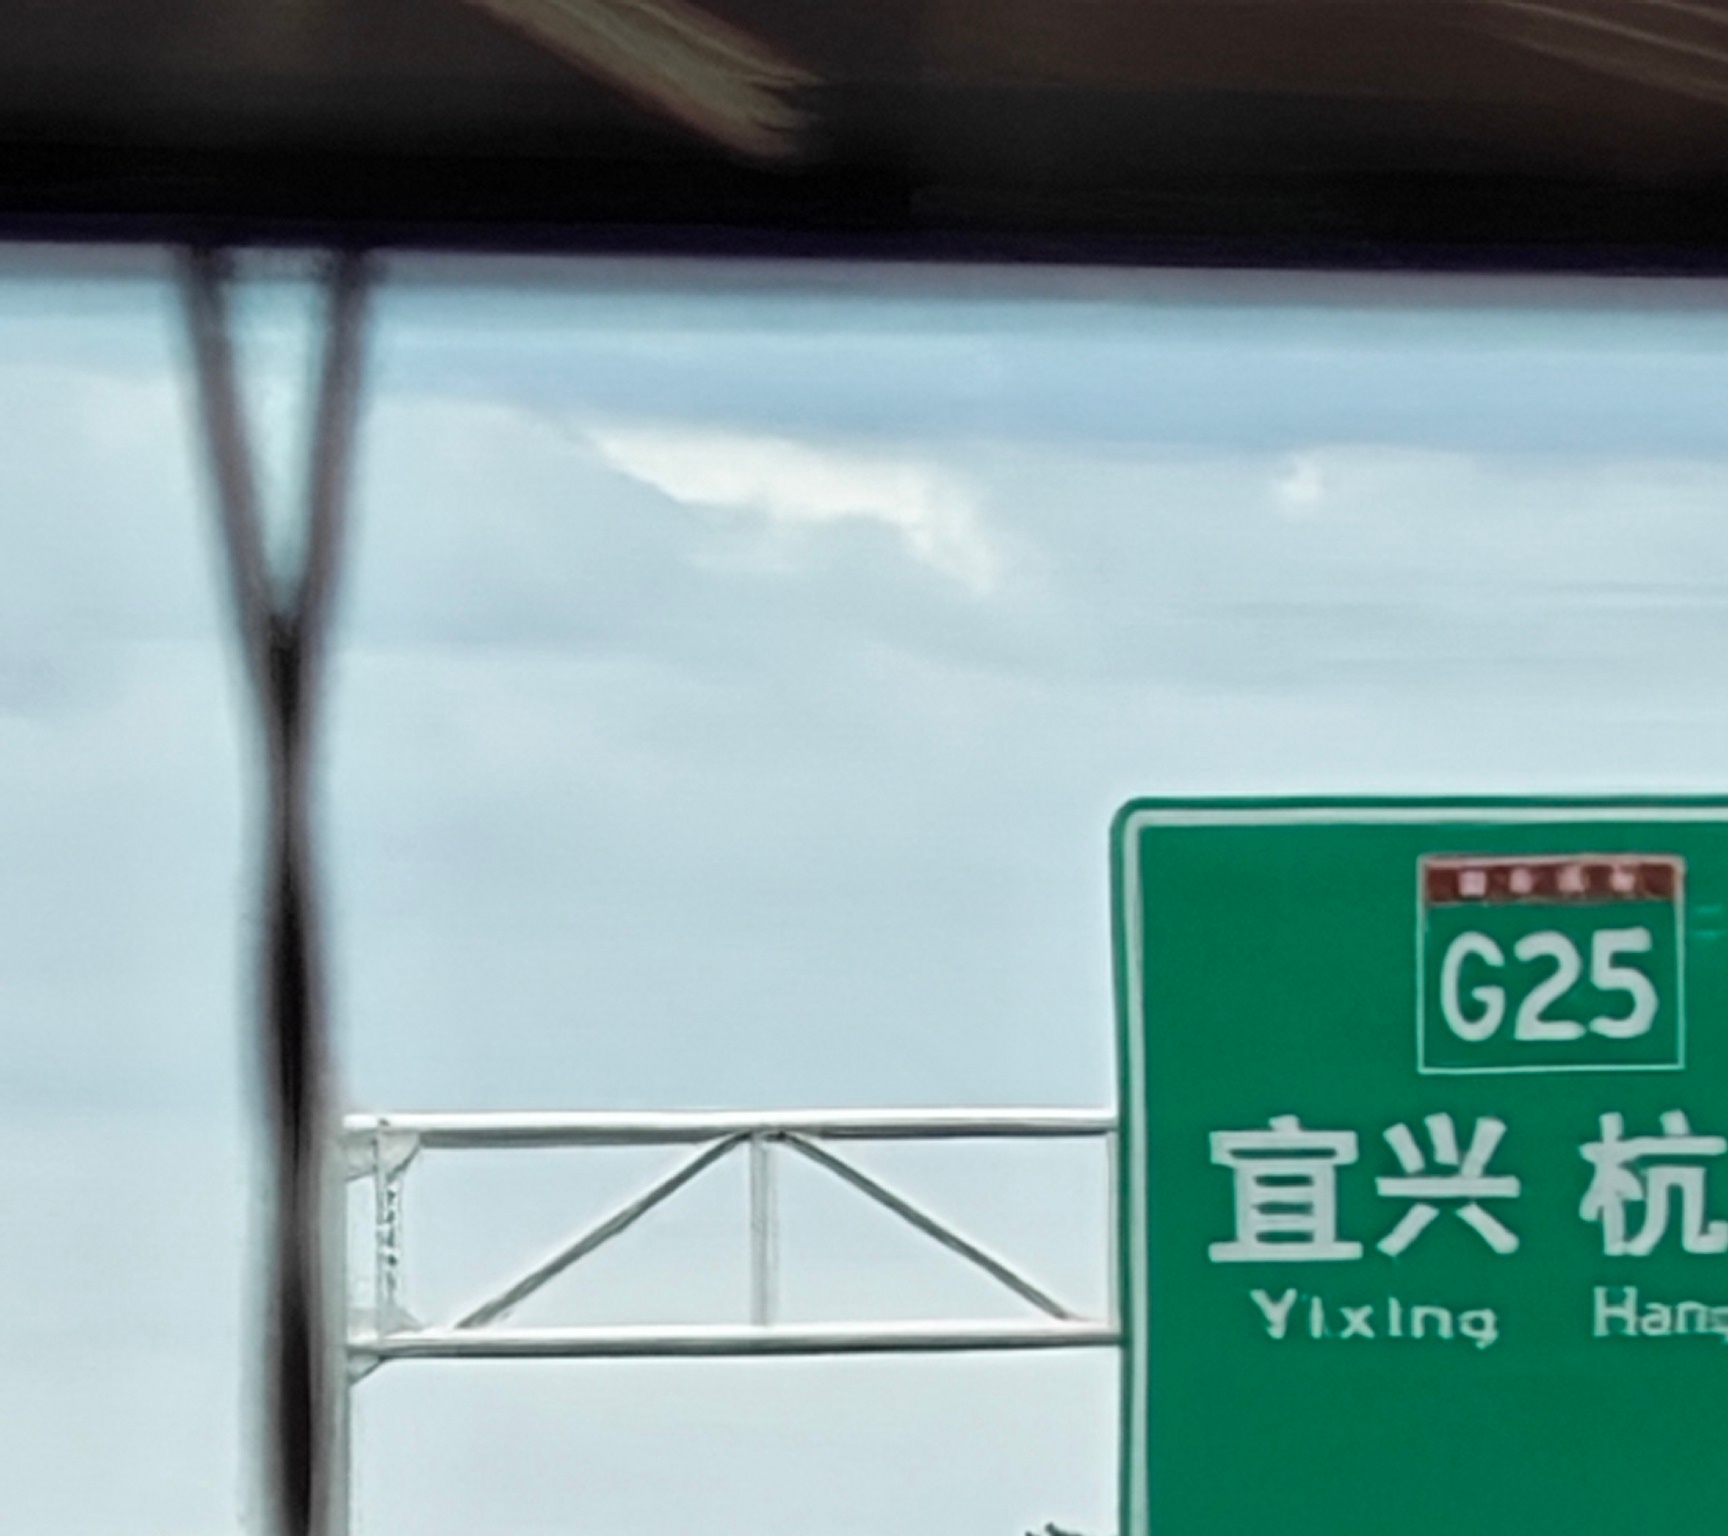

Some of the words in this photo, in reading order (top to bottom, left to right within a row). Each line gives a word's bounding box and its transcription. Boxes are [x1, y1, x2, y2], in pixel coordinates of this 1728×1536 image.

[1440, 926, 1660, 1042] G25
[1208, 1114, 1521, 1263] 宜兴
[1250, 1288, 1499, 1349] Yixing
